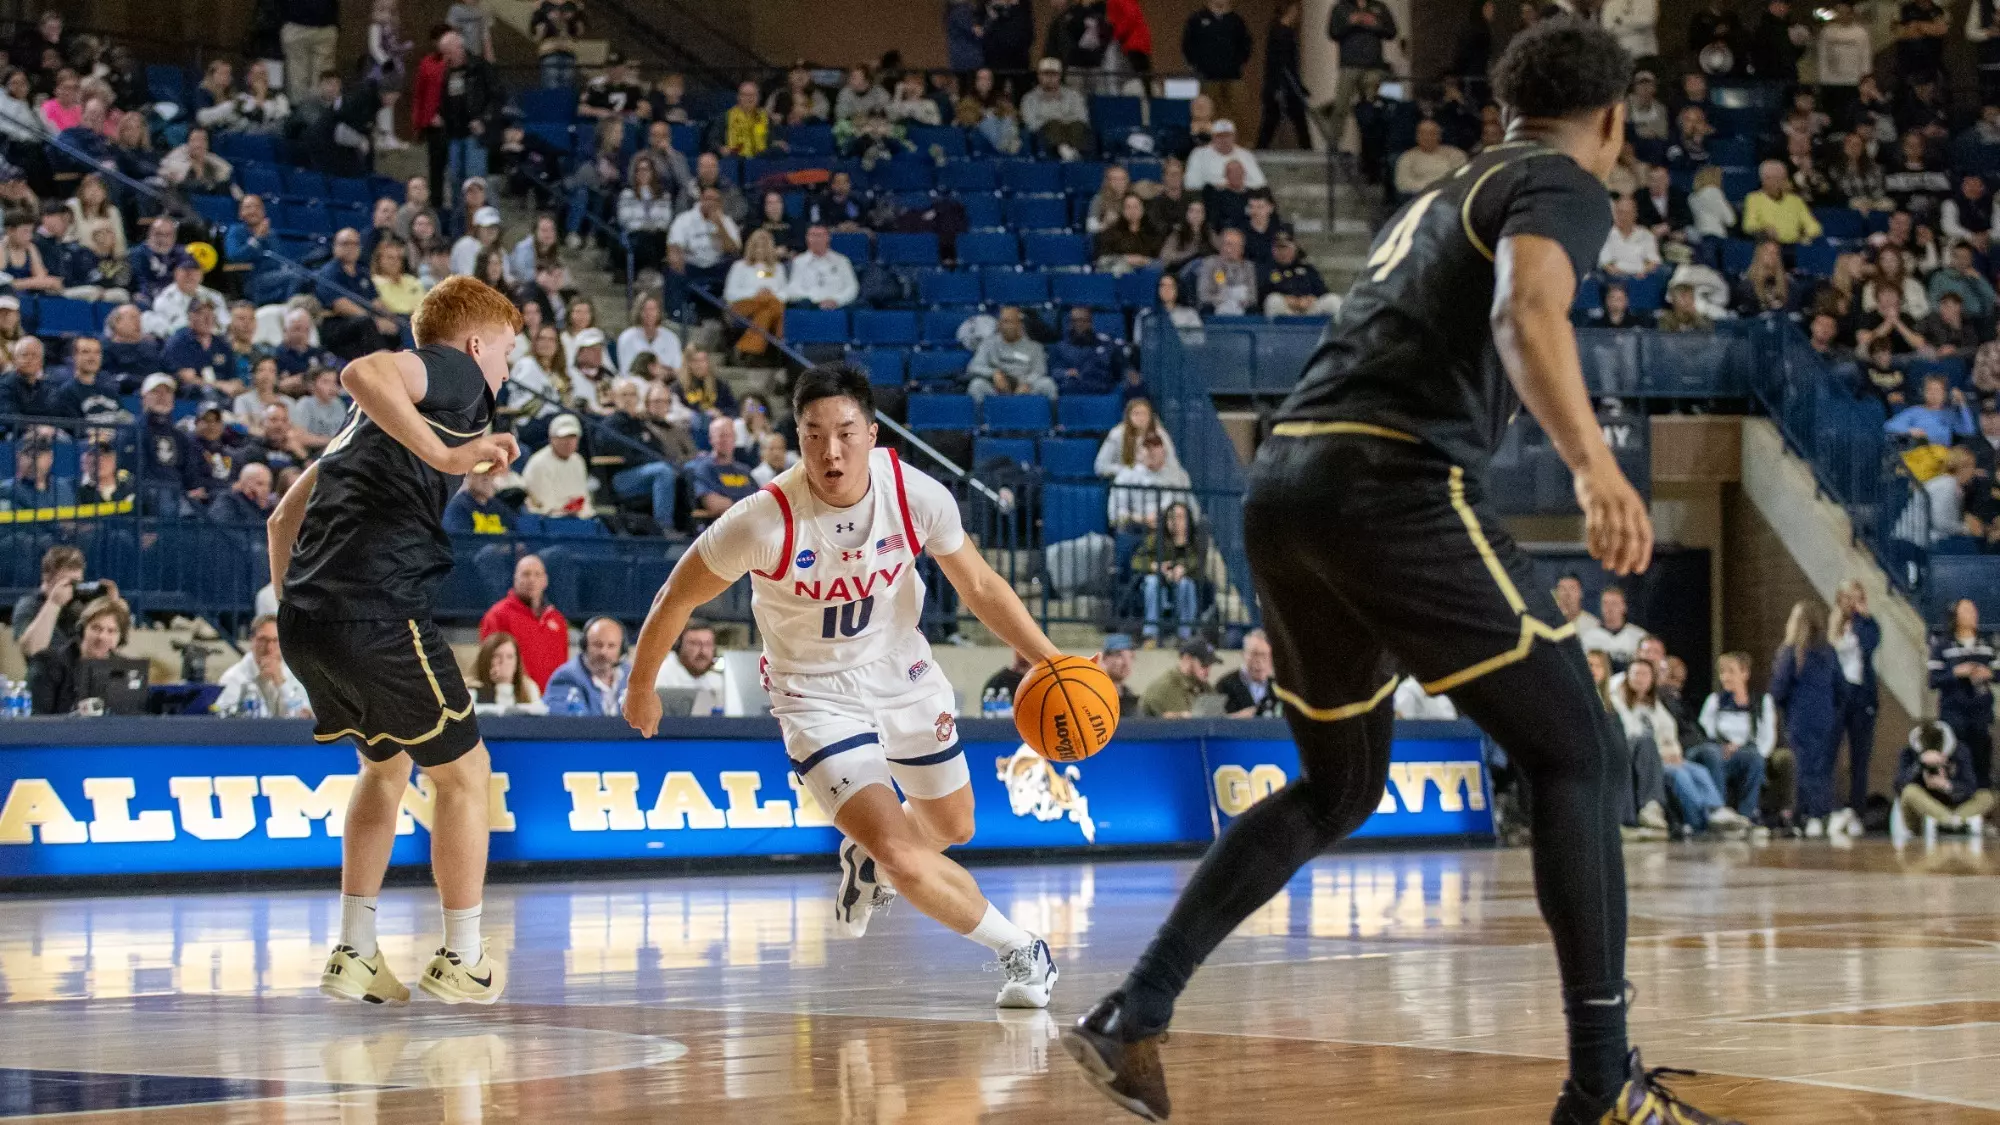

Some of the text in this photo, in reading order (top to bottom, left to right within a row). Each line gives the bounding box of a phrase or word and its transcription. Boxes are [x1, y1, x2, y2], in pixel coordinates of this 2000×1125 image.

[1367, 188, 1443, 283] 4
[796, 555, 815, 563] NASA
[795, 562, 903, 601] NAVY
[822, 595, 874, 638] 10
[1213, 763, 1287, 817] GO
